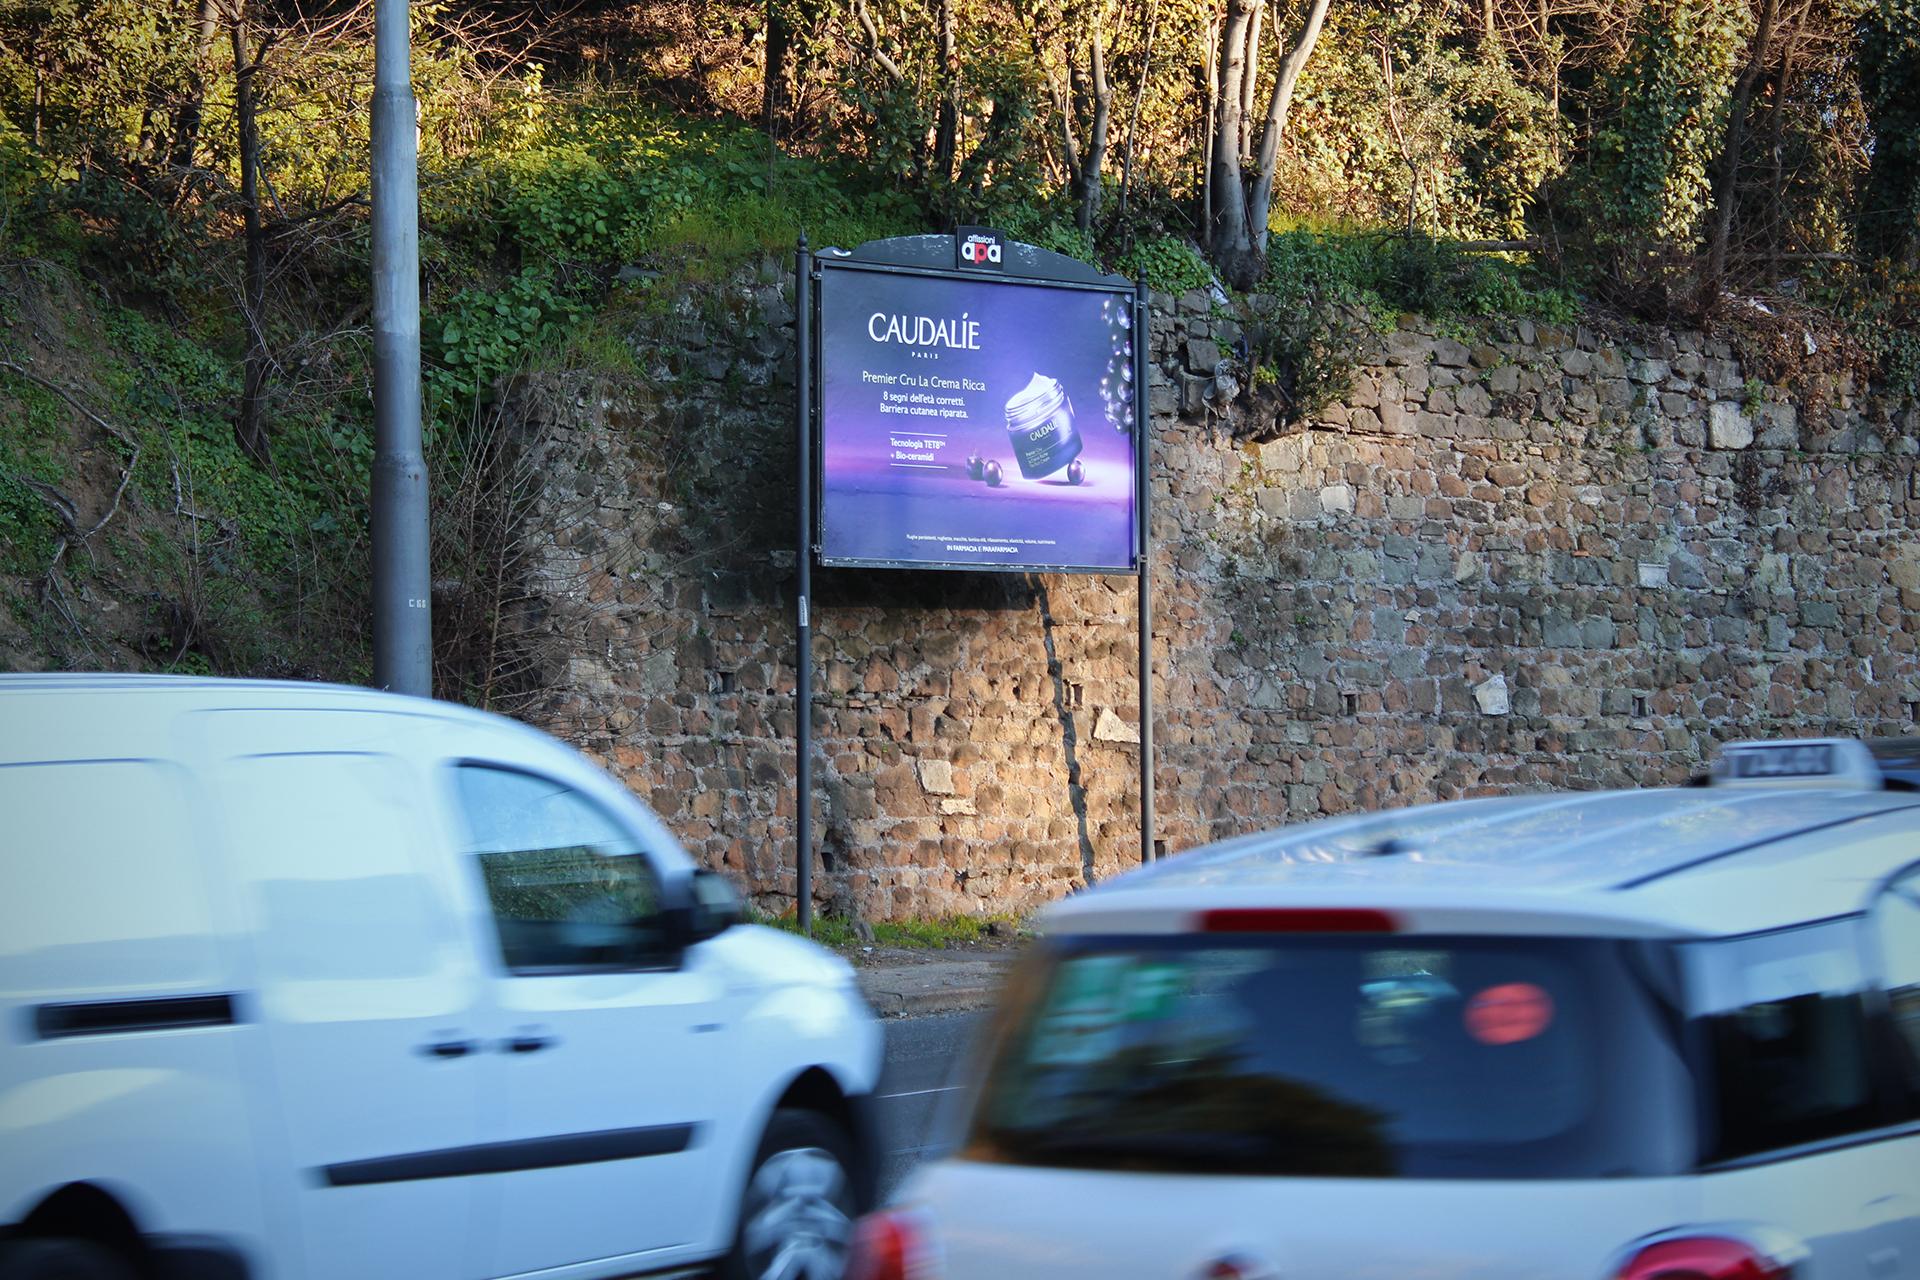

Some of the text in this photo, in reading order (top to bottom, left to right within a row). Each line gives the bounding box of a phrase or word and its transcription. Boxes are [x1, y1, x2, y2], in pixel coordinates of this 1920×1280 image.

[961, 242, 1001, 264] apa
[911, 351, 939, 359] PARIS
[862, 370, 986, 392] Premier Cru La Crema Ricca
[883, 391, 966, 407] 8 segni dell'età corretti.
[880, 402, 969, 419] Barriera cutanea riparata.
[890, 437, 924, 450] Tecnologia
[895, 450, 935, 462] Bio-ceramidi
[953, 544, 978, 553] FARMACIA
[982, 545, 1019, 554] PARAFARMACIA
